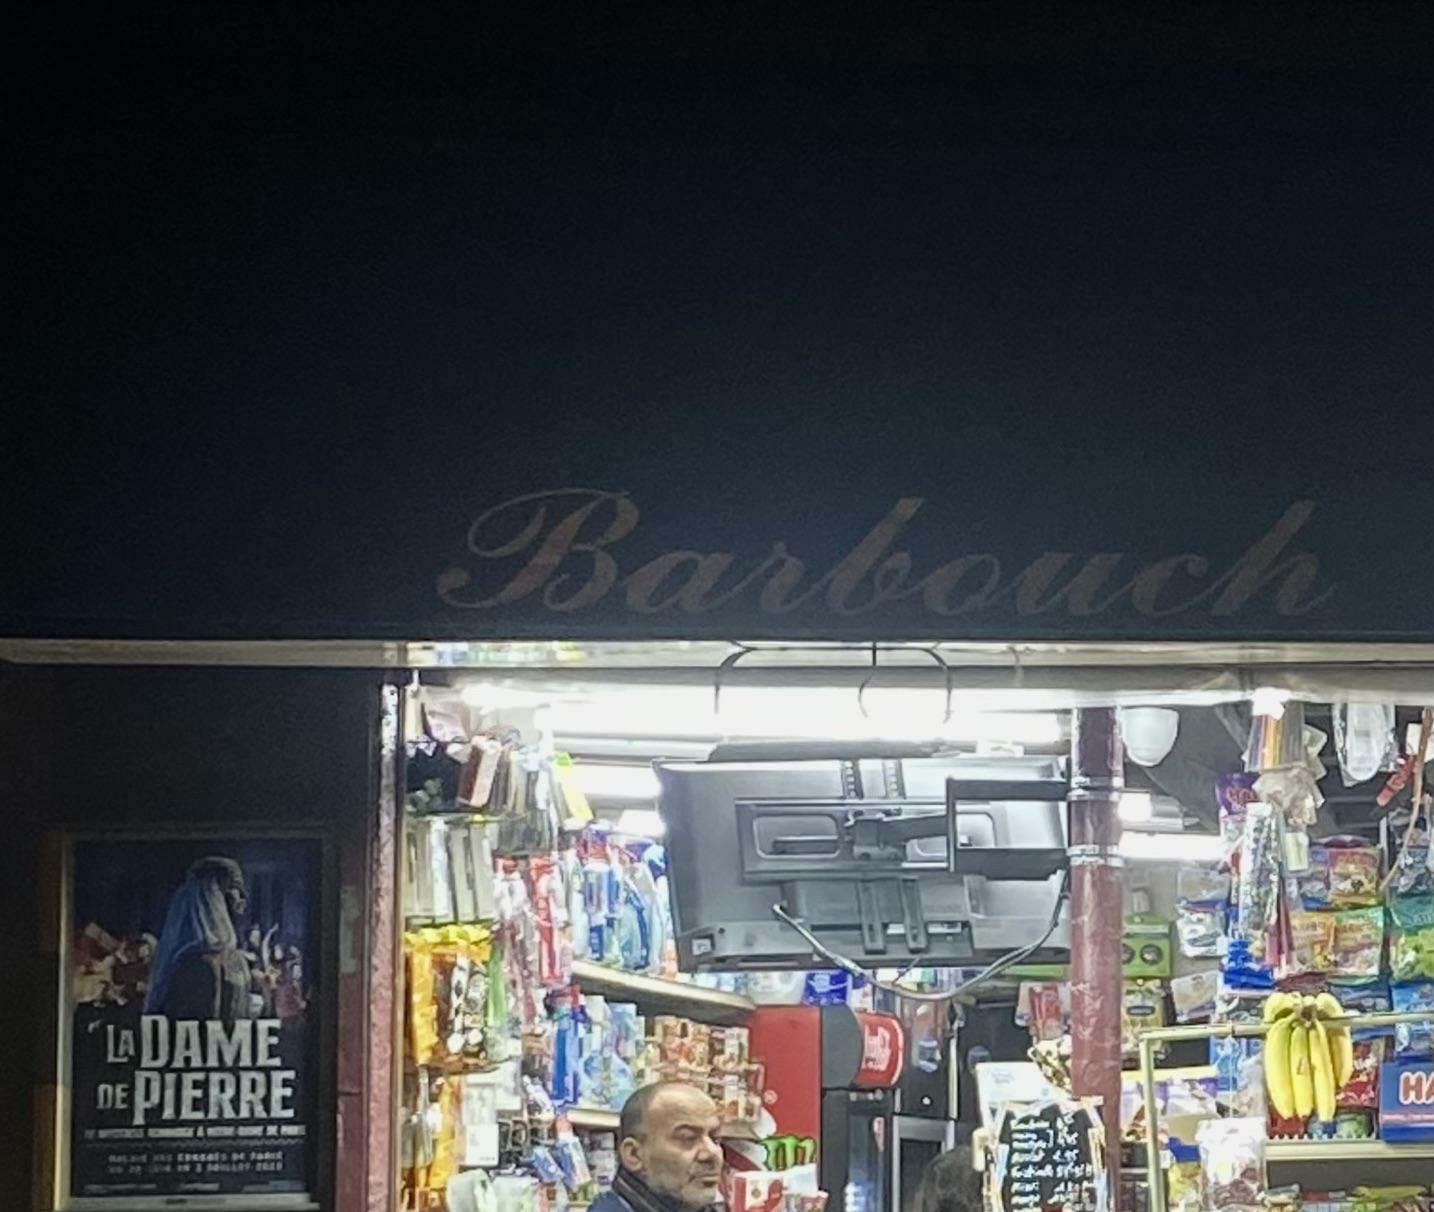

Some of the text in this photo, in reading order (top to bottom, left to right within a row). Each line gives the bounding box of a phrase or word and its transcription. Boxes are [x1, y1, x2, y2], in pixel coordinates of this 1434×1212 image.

[436, 487, 1333, 616] Barbouch
[140, 1014, 282, 1068] DAME
[96, 1069, 296, 1126] DE PIERRE
